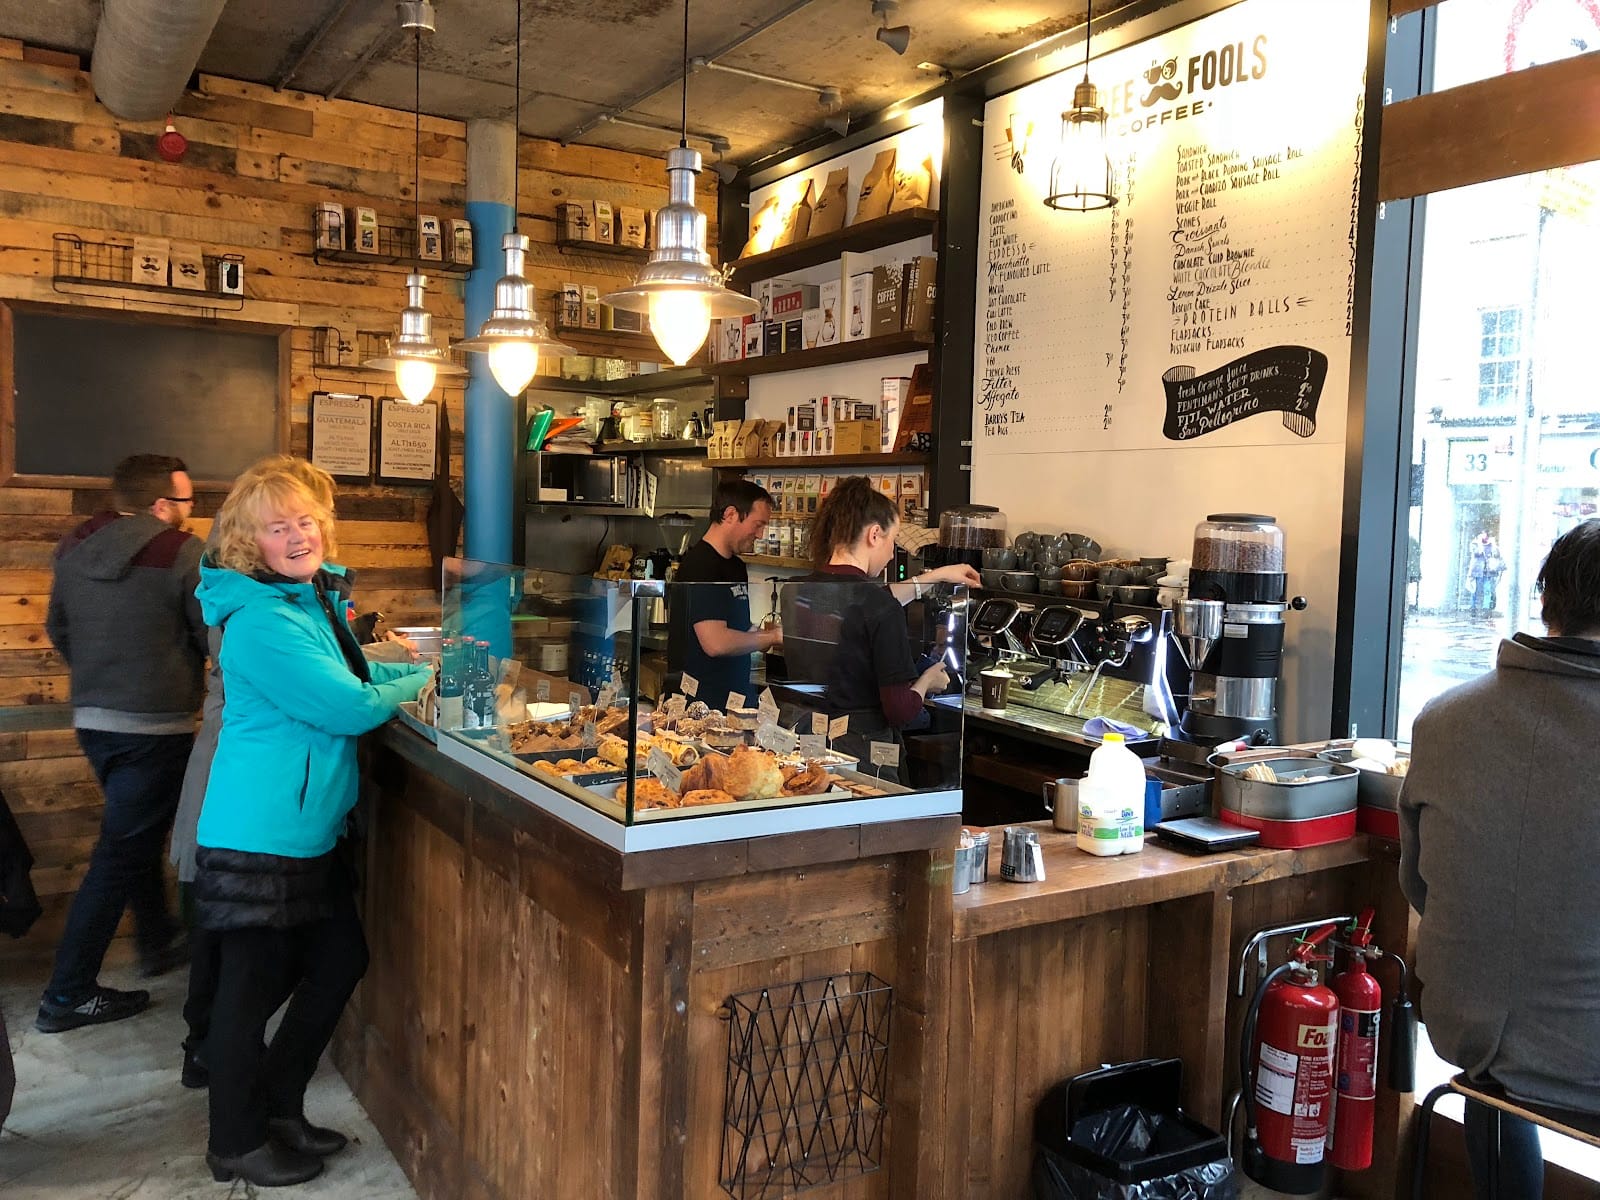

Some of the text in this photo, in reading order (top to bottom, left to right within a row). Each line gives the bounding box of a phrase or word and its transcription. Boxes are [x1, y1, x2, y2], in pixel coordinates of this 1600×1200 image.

[1188, 35, 1267, 94] FOOLS
[1231, 173, 1259, 190] SAUSAGE
[1263, 167, 1281, 181] ROLL
[1176, 197, 1216, 215] VEGGIE ROLL
[1226, 248, 1255, 262] BROWNIE
[877, 289, 896, 304] COFFEE
[1183, 297, 1290, 326] PROTEIN BALLS
[1171, 326, 1212, 341] FLAPJACKS
[1206, 337, 1245, 351] FLAPJACKS
[1250, 366, 1280, 383] DRINKS
[982, 377, 1012, 391] Filter
[319, 399, 360, 409] ESPRESSO
[1207, 388, 1251, 414] WATER
[388, 405, 425, 414] ESPRESSO
[316, 416, 367, 426] GUATEMALA
[1010, 411, 1025, 423] TEA
[387, 421, 412, 429] COSTA
[1178, 425, 1197, 439] San
[1464, 453, 1488, 472] 33
